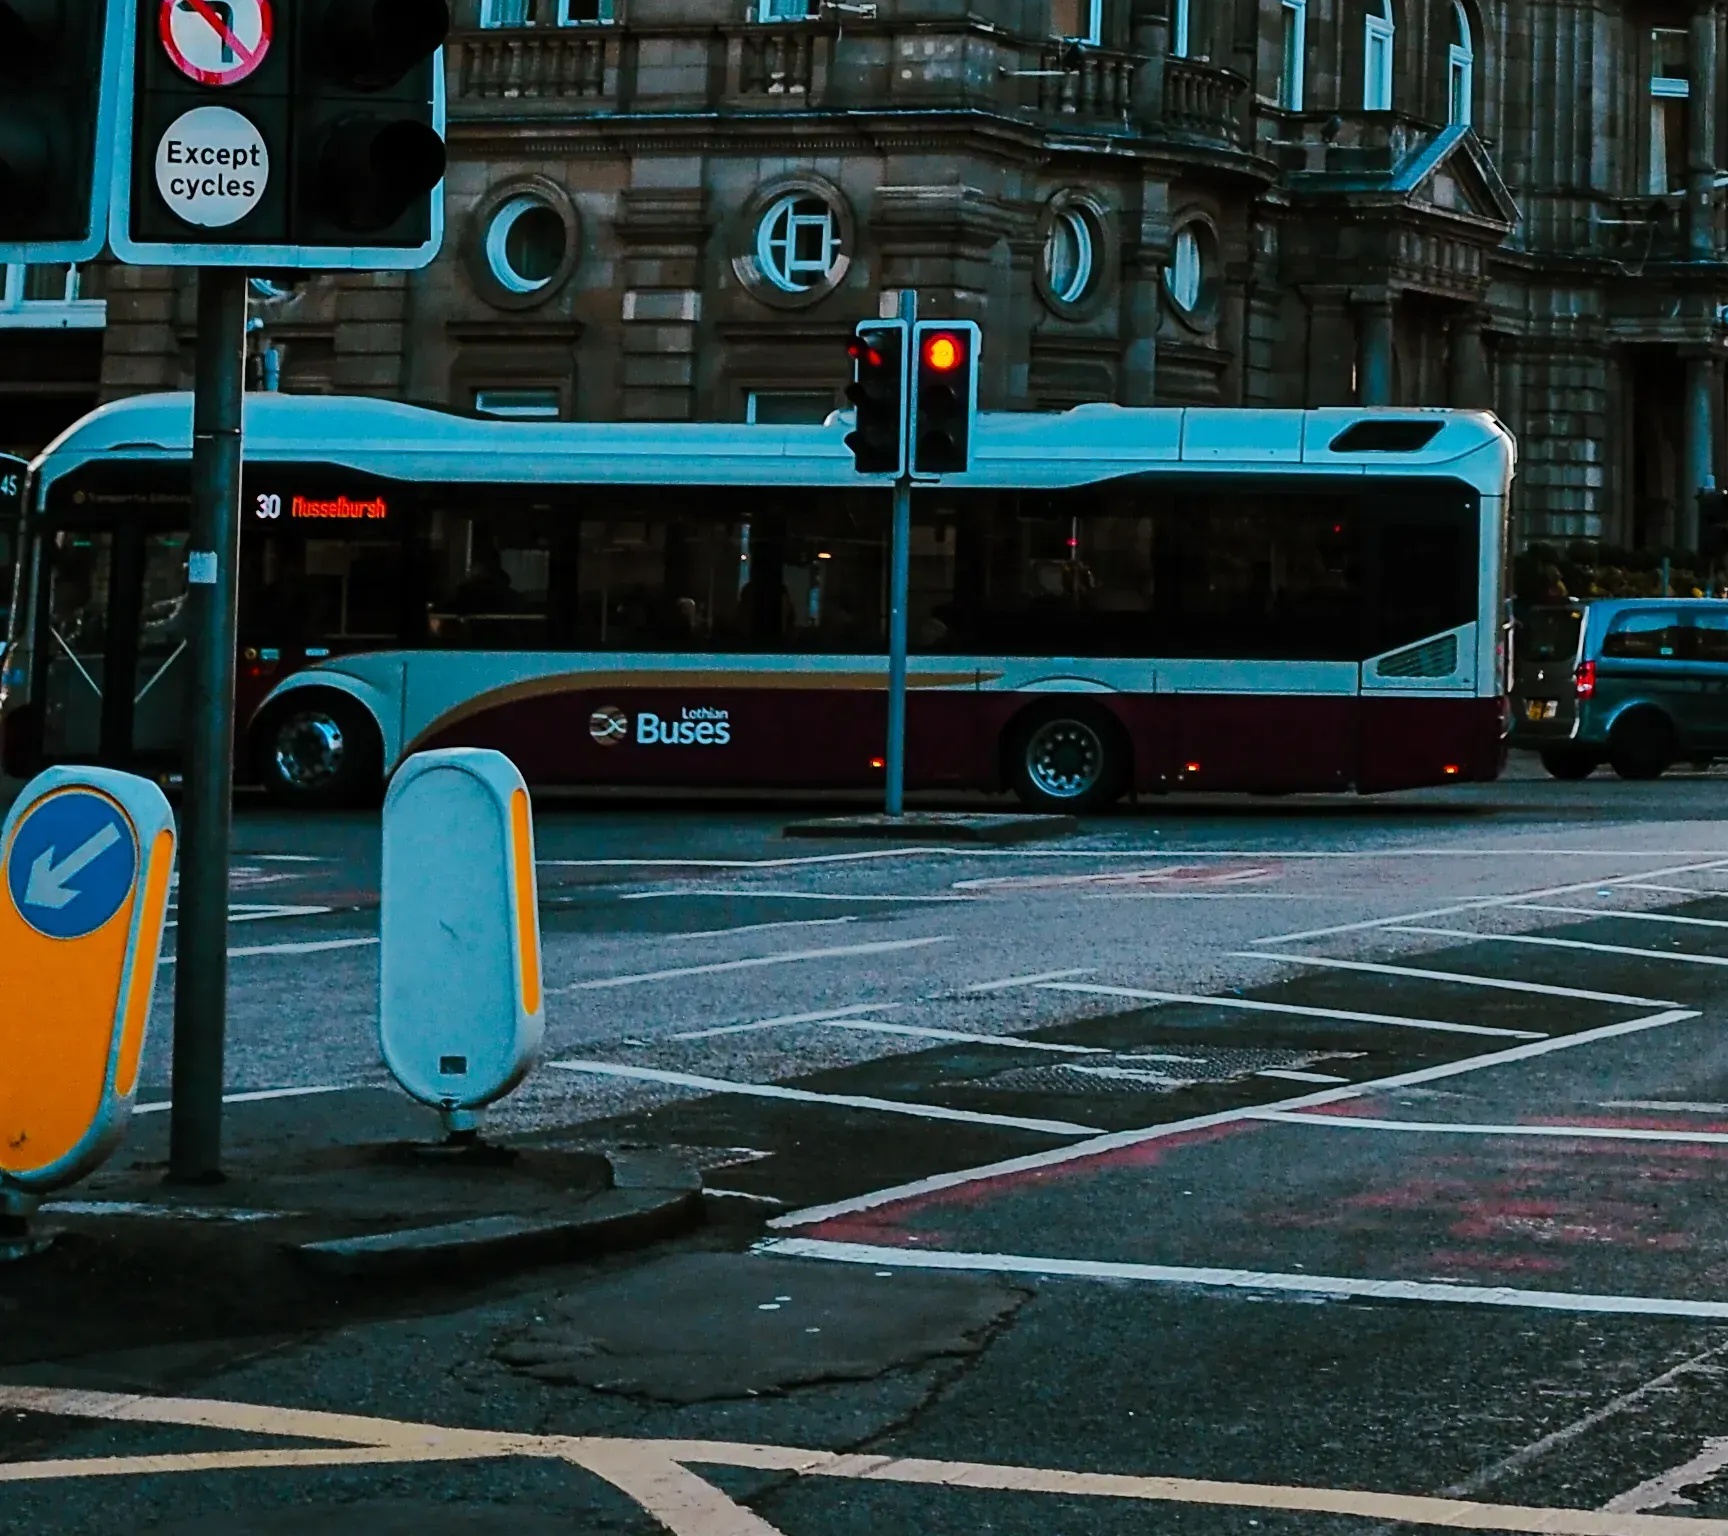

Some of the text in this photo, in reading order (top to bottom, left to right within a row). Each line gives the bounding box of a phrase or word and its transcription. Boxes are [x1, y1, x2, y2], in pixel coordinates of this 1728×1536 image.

[167, 140, 260, 170] Except
[170, 173, 256, 200] cycles
[255, 493, 282, 519] 30
[682, 705, 729, 719] Lothian
[636, 712, 731, 745] Buses
